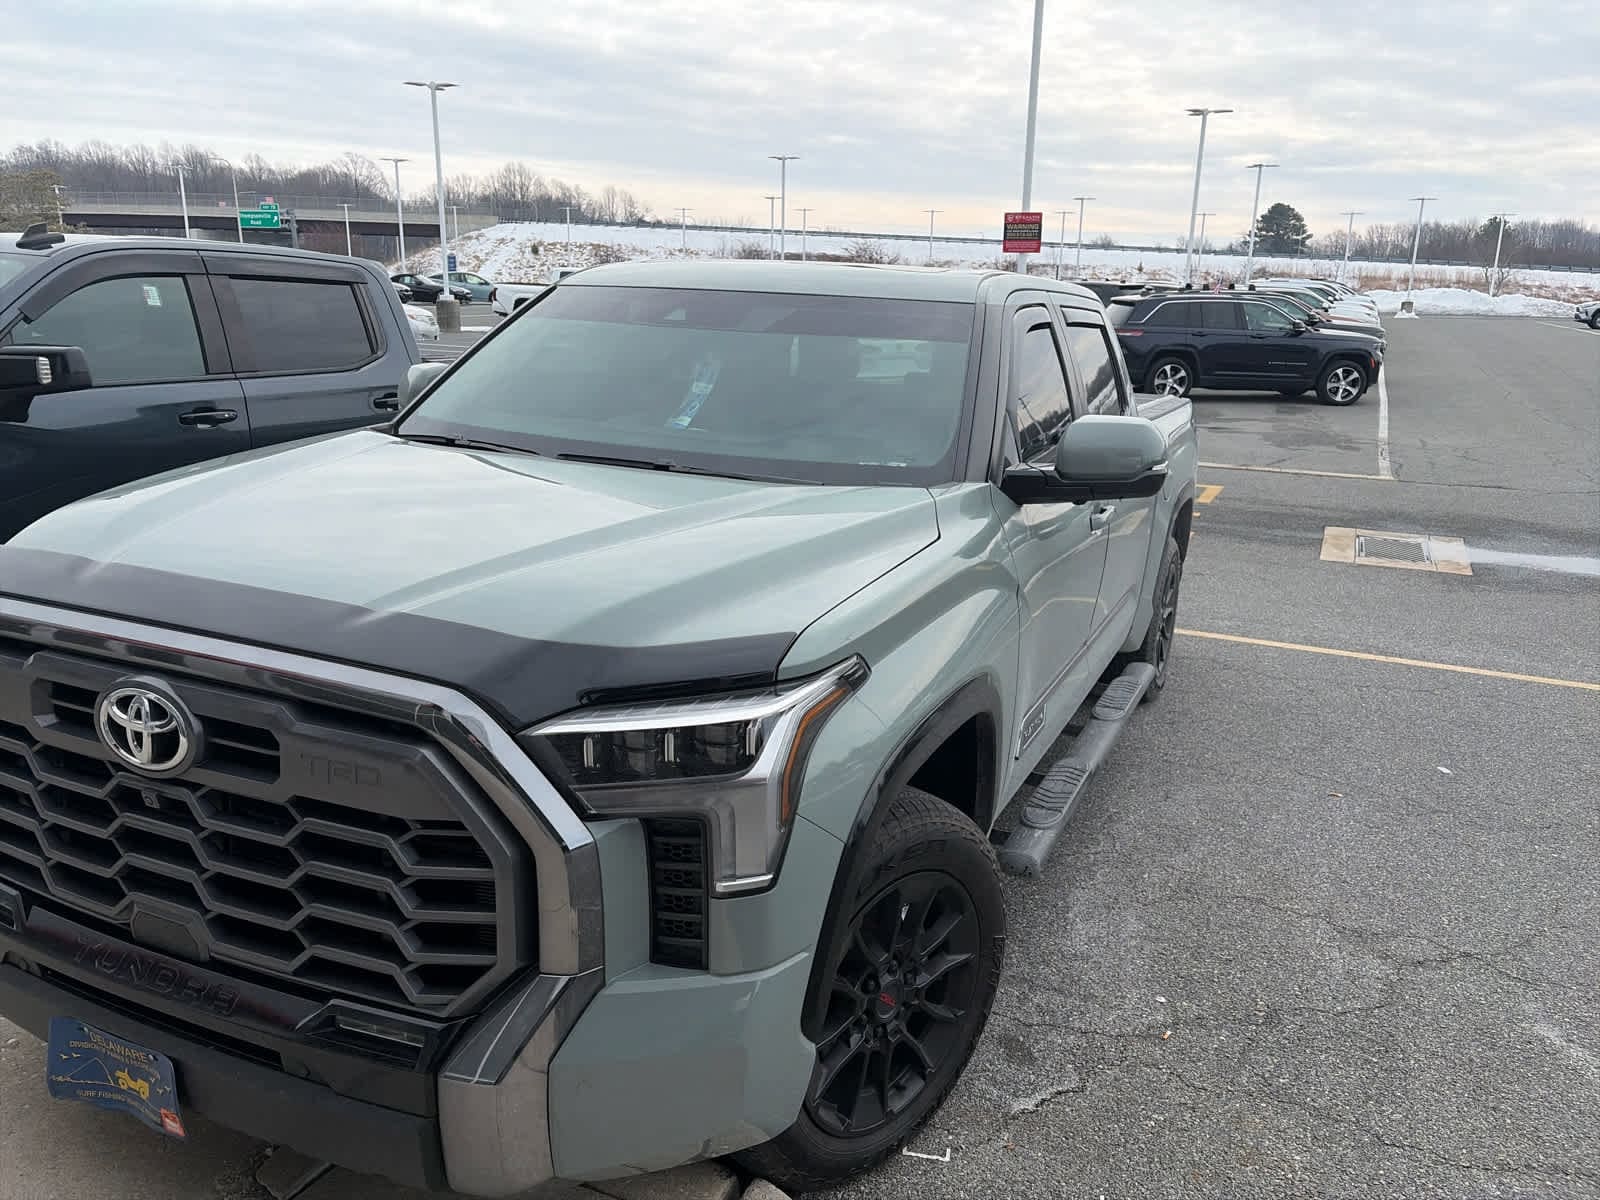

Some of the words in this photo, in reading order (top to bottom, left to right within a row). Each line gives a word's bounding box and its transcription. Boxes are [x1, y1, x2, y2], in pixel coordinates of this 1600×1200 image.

[299, 751, 384, 787] TRD
[73, 935, 240, 1015] TUNDRA
[89, 1031, 149, 1063] DELAWARE
